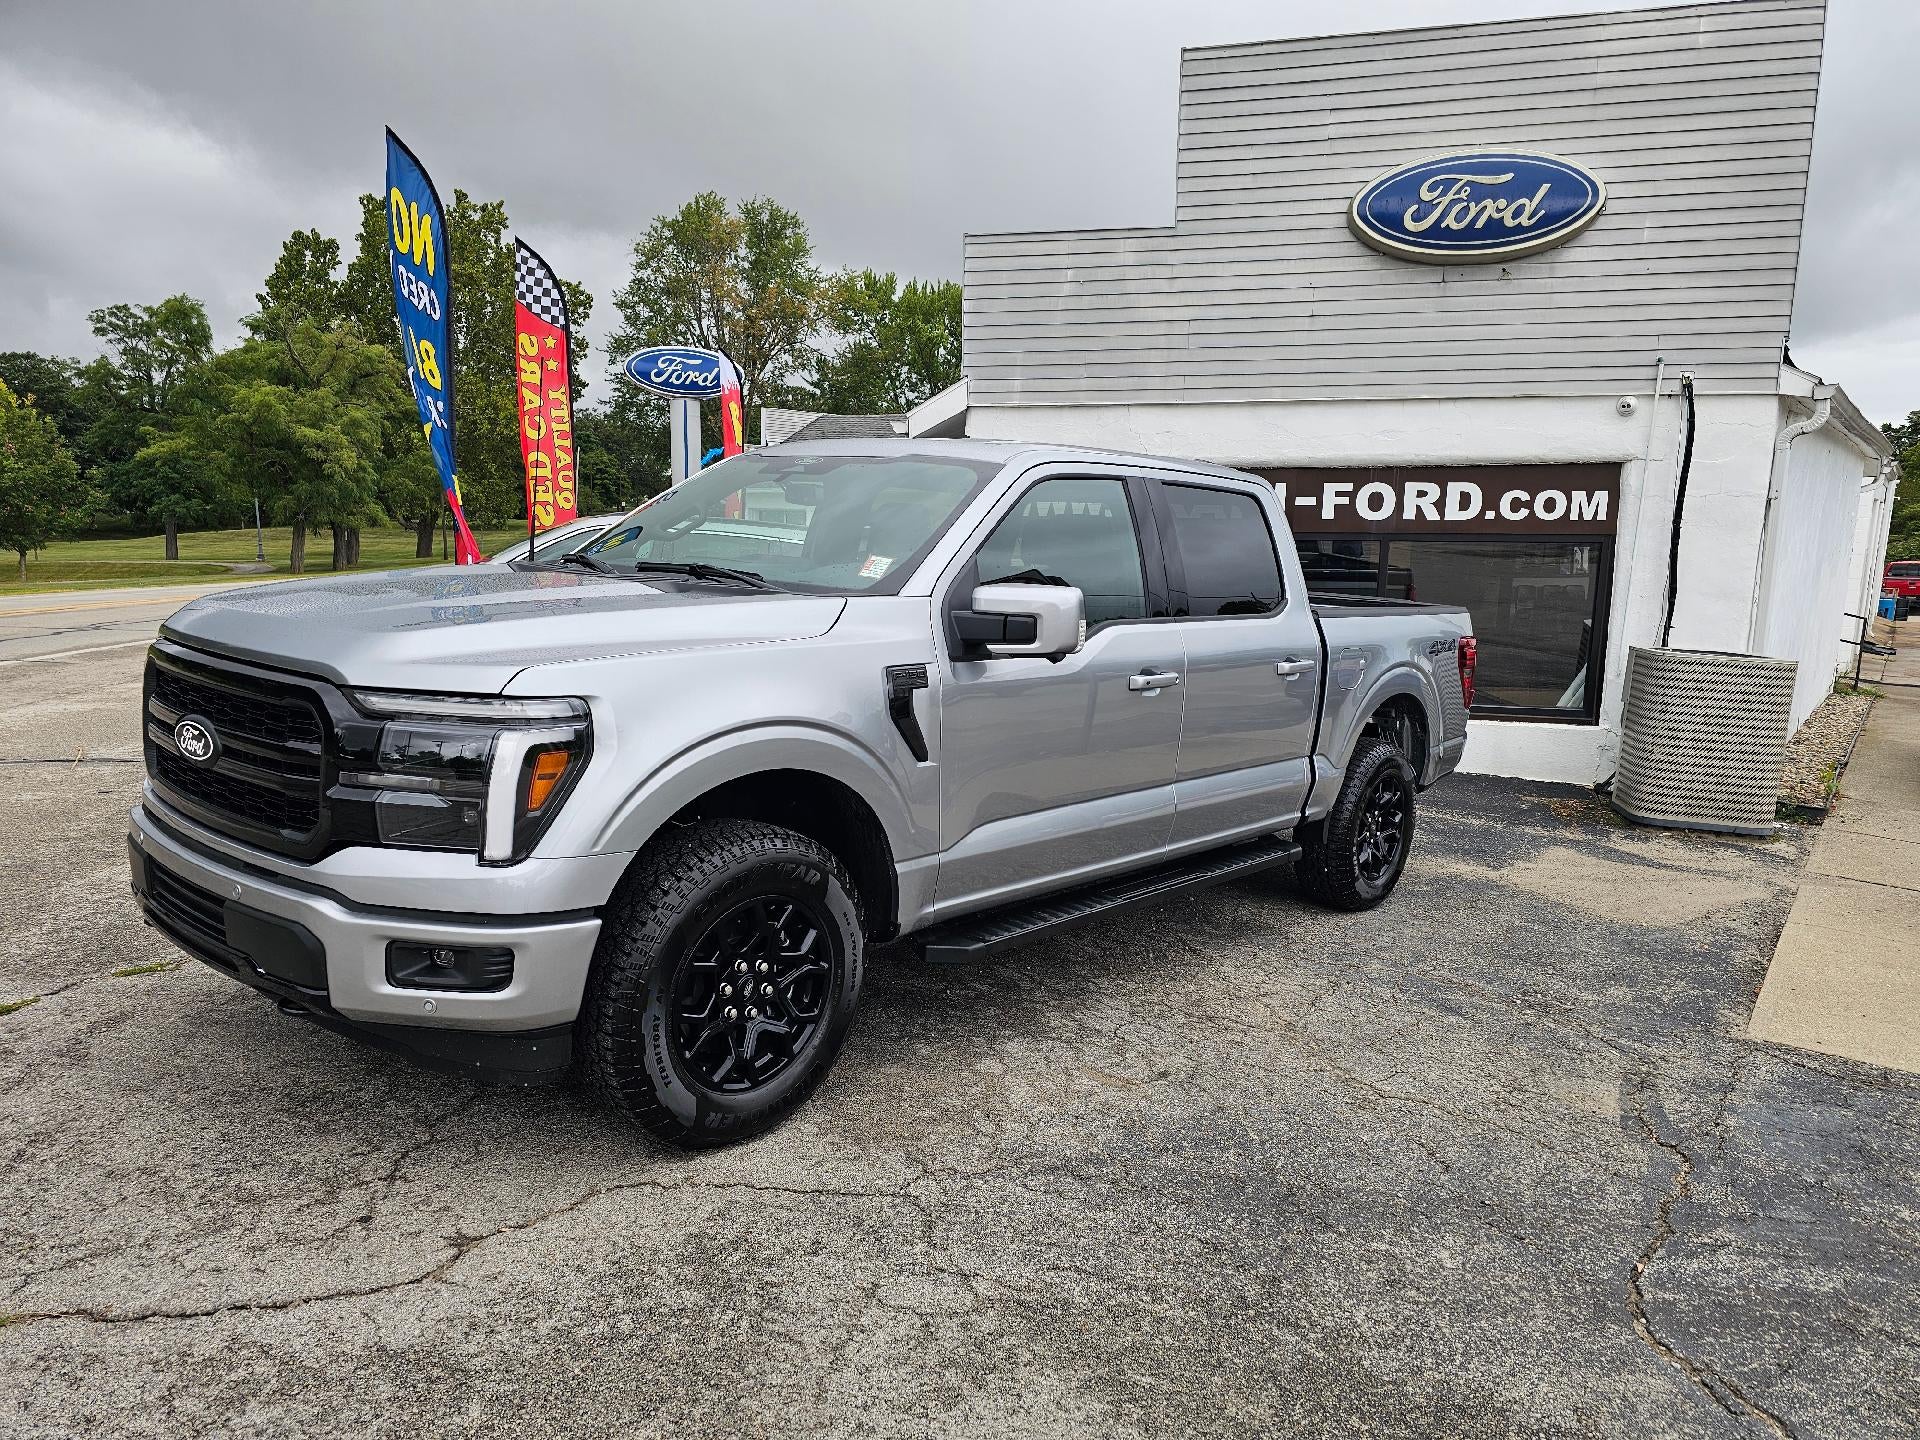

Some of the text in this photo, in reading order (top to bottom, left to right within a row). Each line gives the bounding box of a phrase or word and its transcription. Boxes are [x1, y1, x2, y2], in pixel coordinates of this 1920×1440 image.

[1403, 172, 1552, 233] Ford
[650, 355, 719, 387] Ford
[180, 725, 205, 756] Ford
[652, 1014, 673, 1089] TERRITORY
